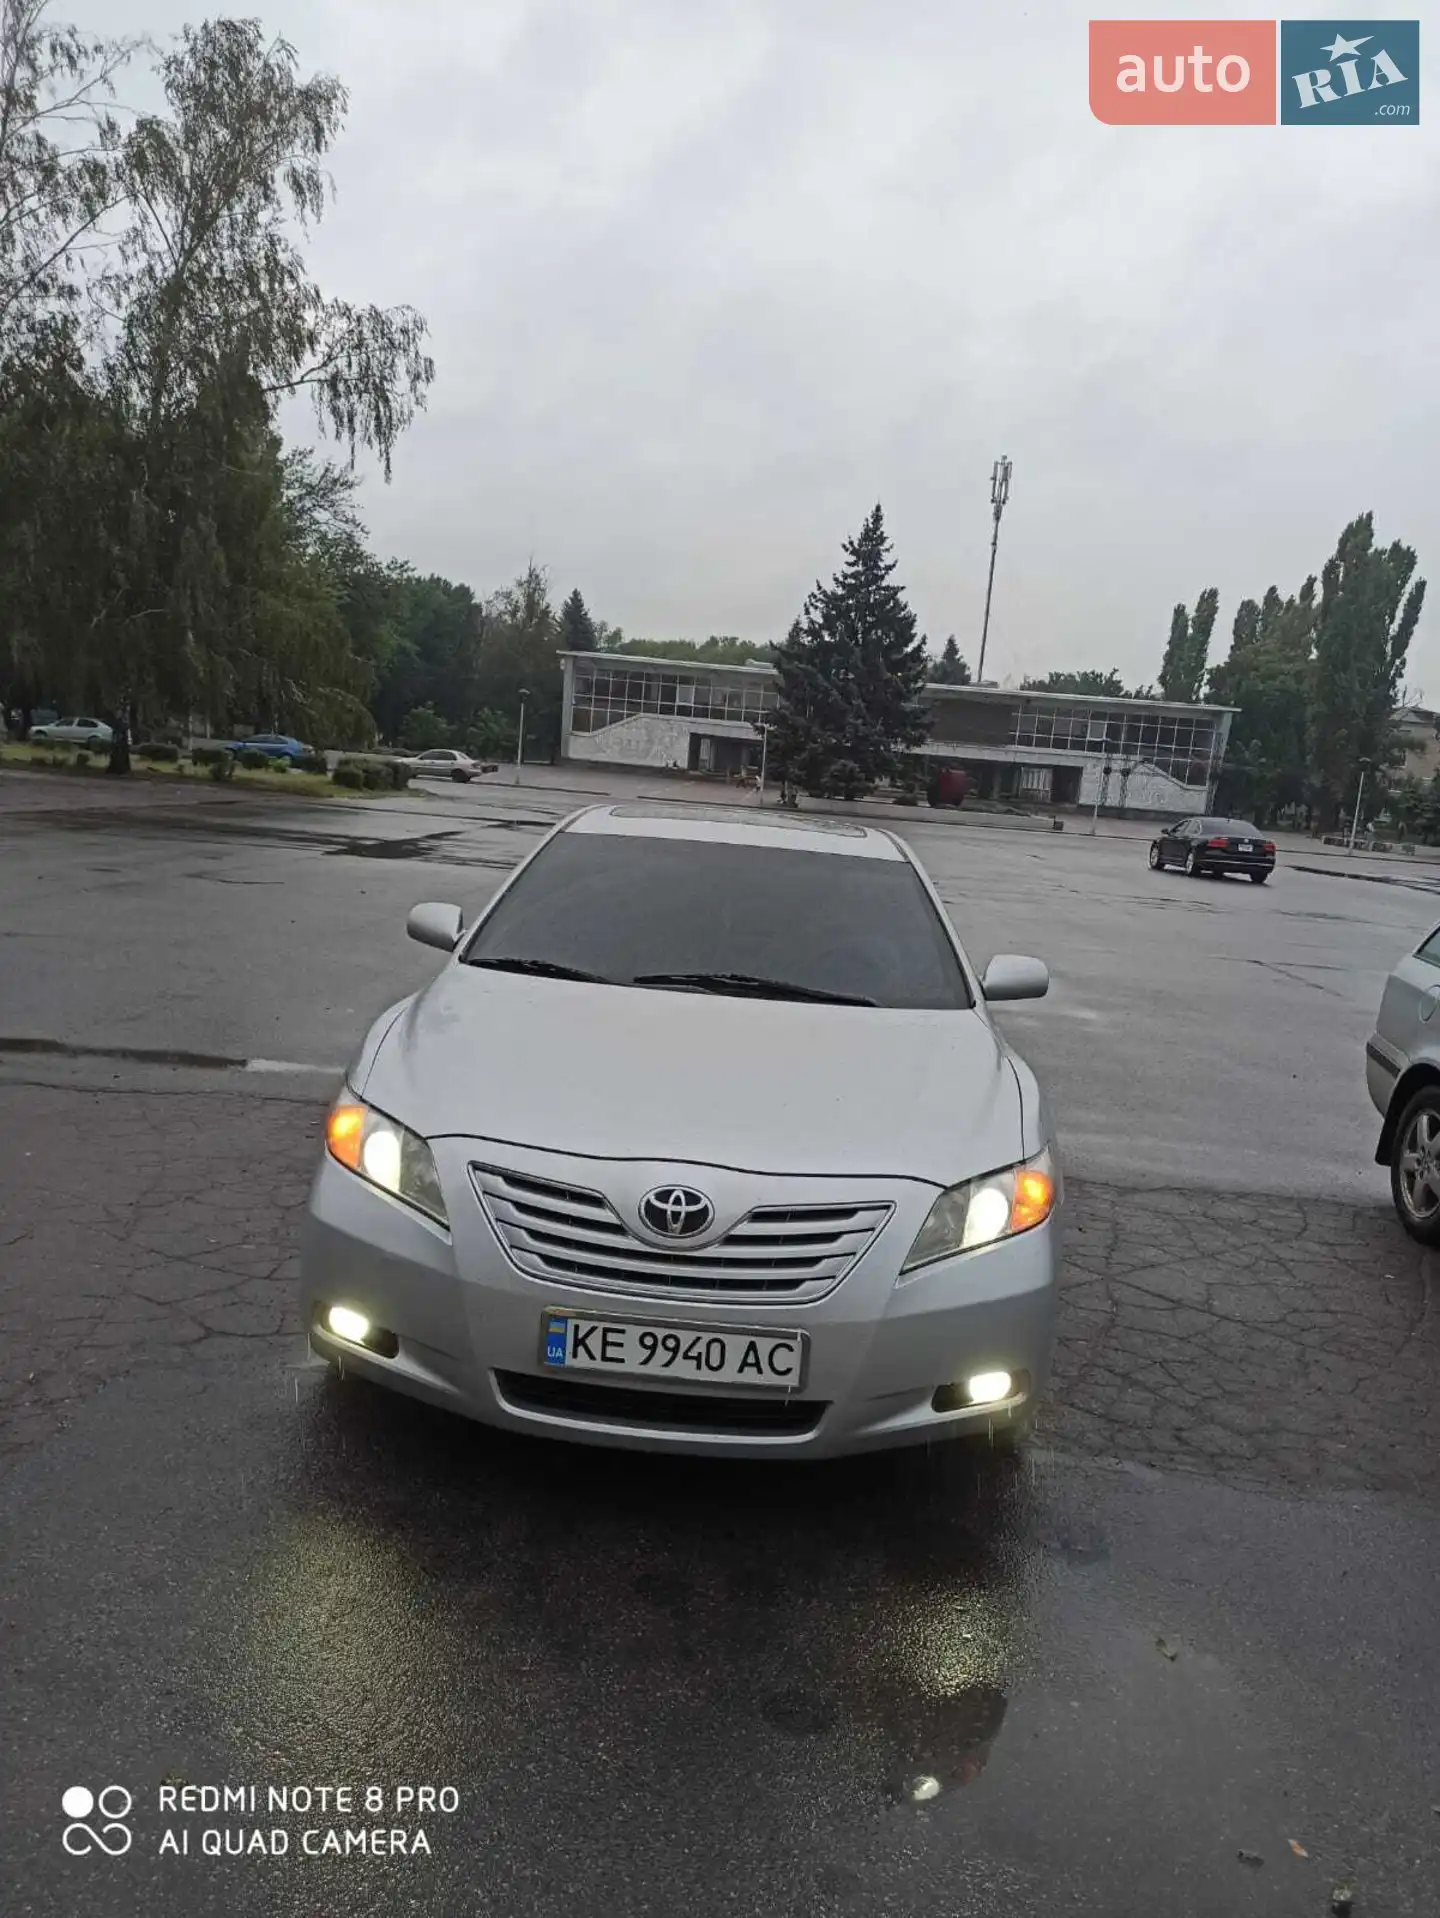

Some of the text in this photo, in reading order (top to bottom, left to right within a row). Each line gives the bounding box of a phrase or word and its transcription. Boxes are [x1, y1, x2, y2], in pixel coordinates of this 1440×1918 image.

[547, 1346, 564, 1358] UA
[571, 1323, 795, 1376] KE 9940 AC
